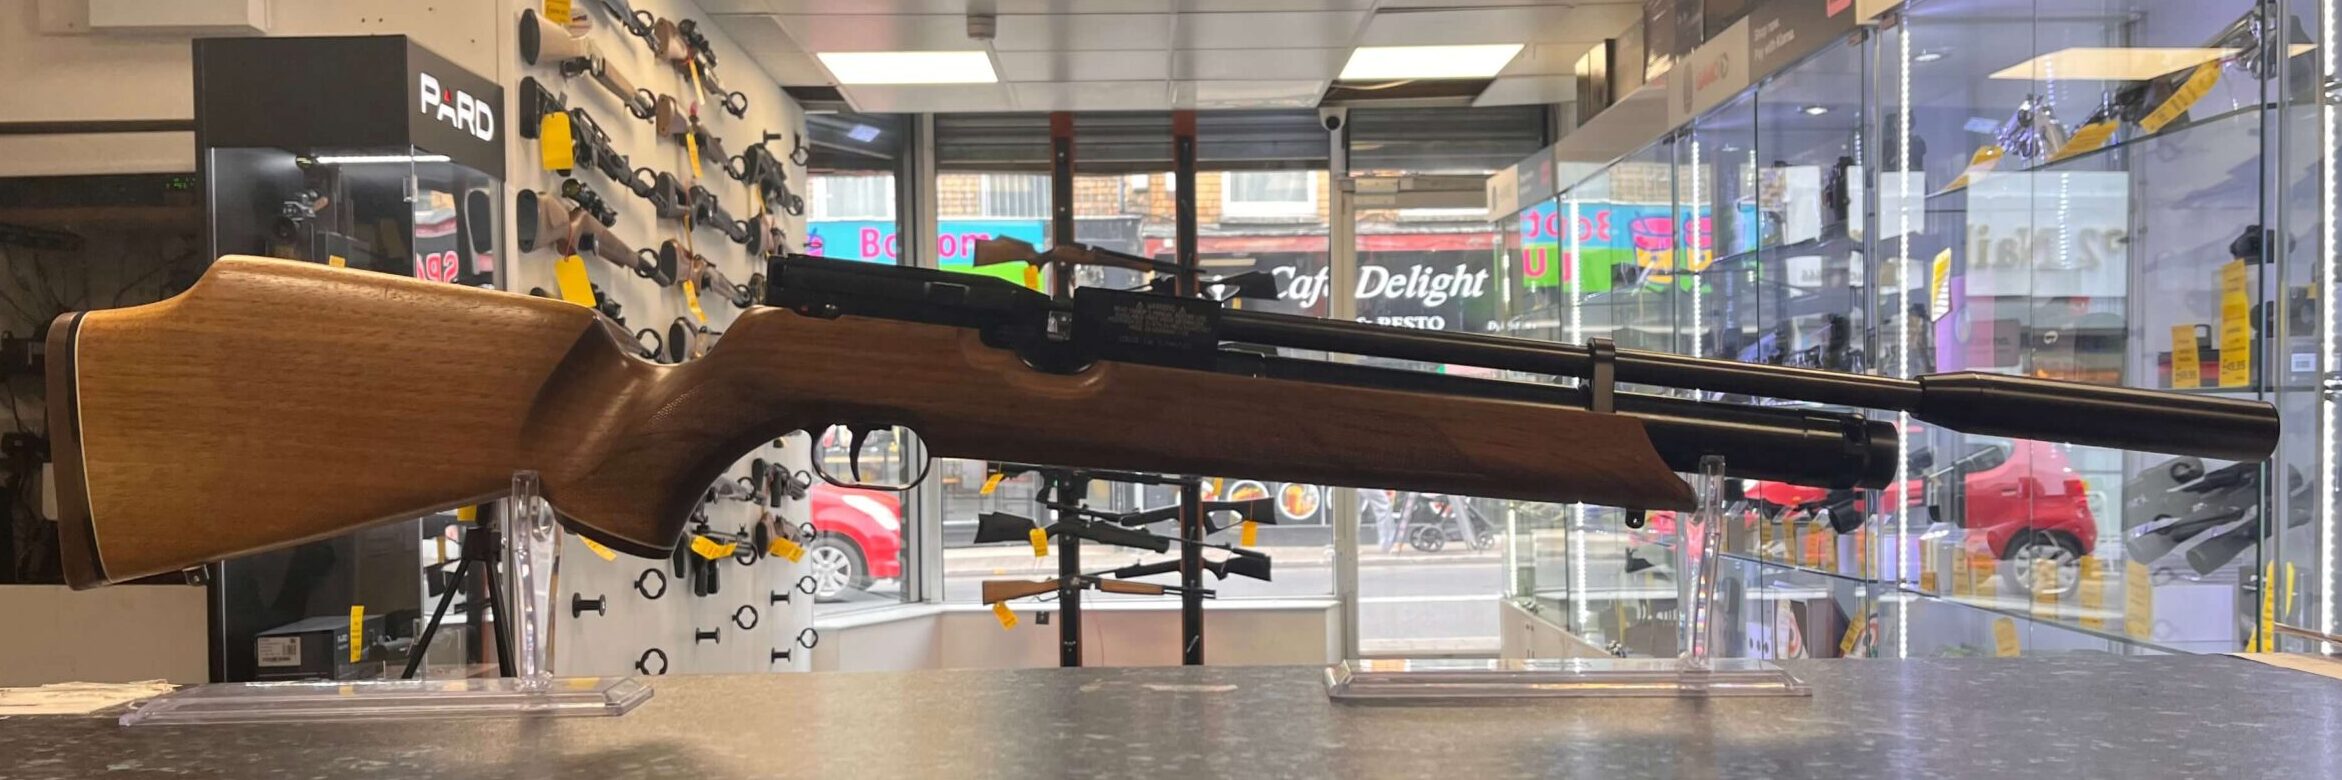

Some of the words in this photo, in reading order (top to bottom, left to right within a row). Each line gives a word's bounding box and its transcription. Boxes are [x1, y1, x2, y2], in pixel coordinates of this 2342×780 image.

[420, 72, 494, 142] PARD
[1271, 265, 1330, 308] Caf
[1354, 264, 1489, 306] Delight
